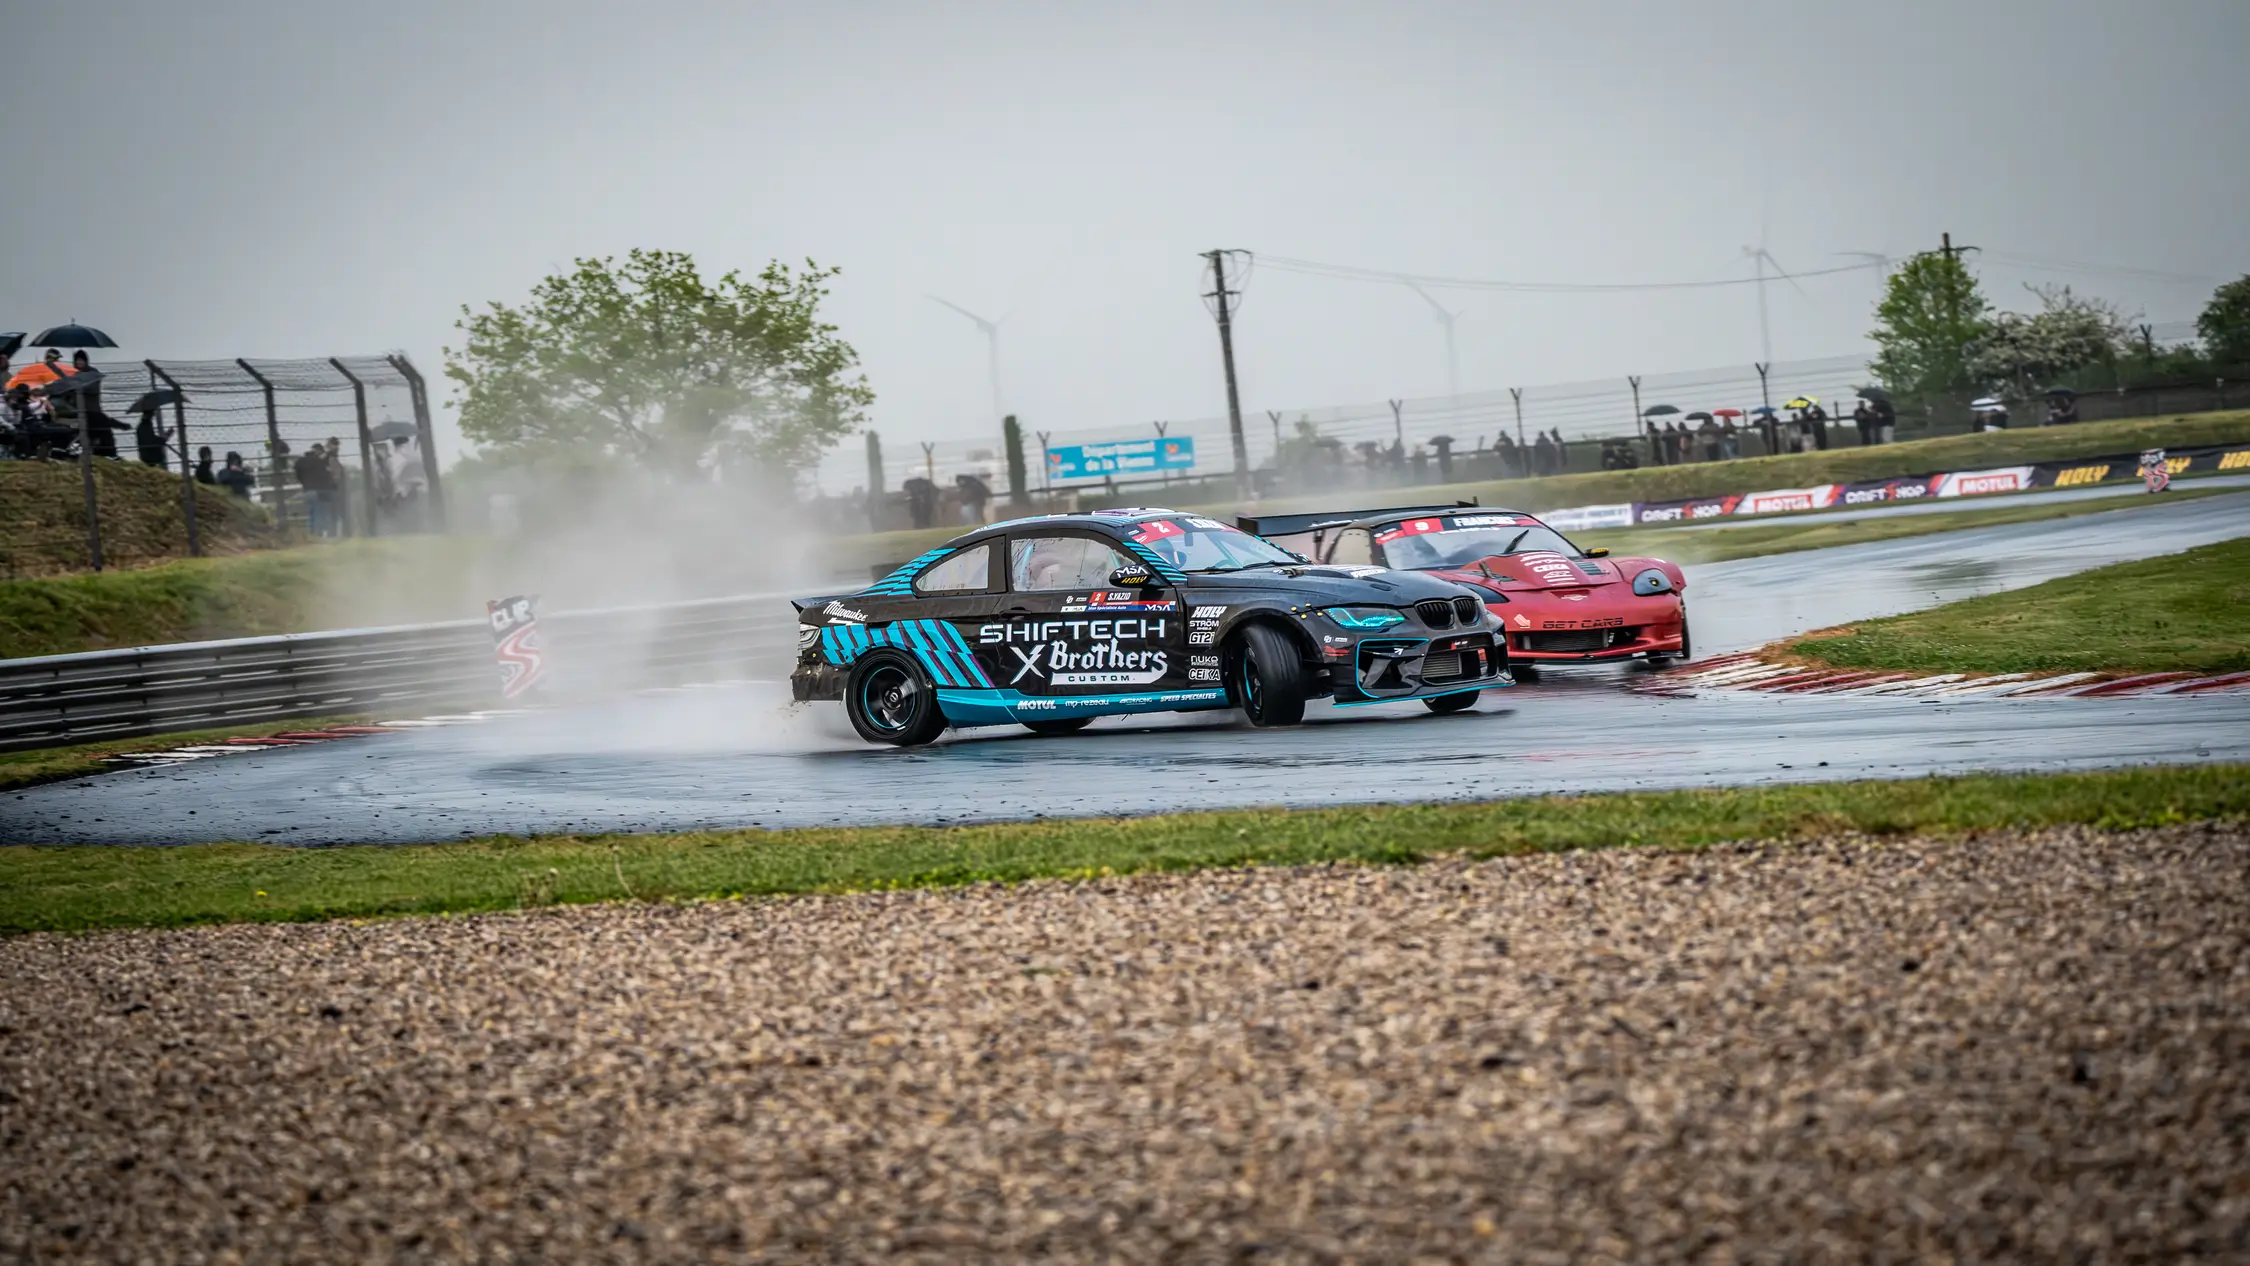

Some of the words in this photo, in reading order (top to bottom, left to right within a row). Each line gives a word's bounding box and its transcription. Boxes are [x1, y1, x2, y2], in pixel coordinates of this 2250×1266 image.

[2055, 465, 2109, 485] HOLY
[1962, 475, 2015, 493] MOTUL
[1151, 522, 1170, 533] 2
[1415, 521, 1429, 531] 9
[1095, 593, 1102, 601] 2
[822, 600, 869, 621] Milwaukee
[1191, 606, 1227, 618] HOLY
[1189, 618, 1220, 627] STRÖM
[979, 619, 1166, 643] SHIFTECH
[1048, 637, 1168, 675] Brothers
[1067, 674, 1130, 683] CUSTOM
[1160, 694, 1181, 703] SPEED
[1017, 699, 1057, 710] MOTUL
